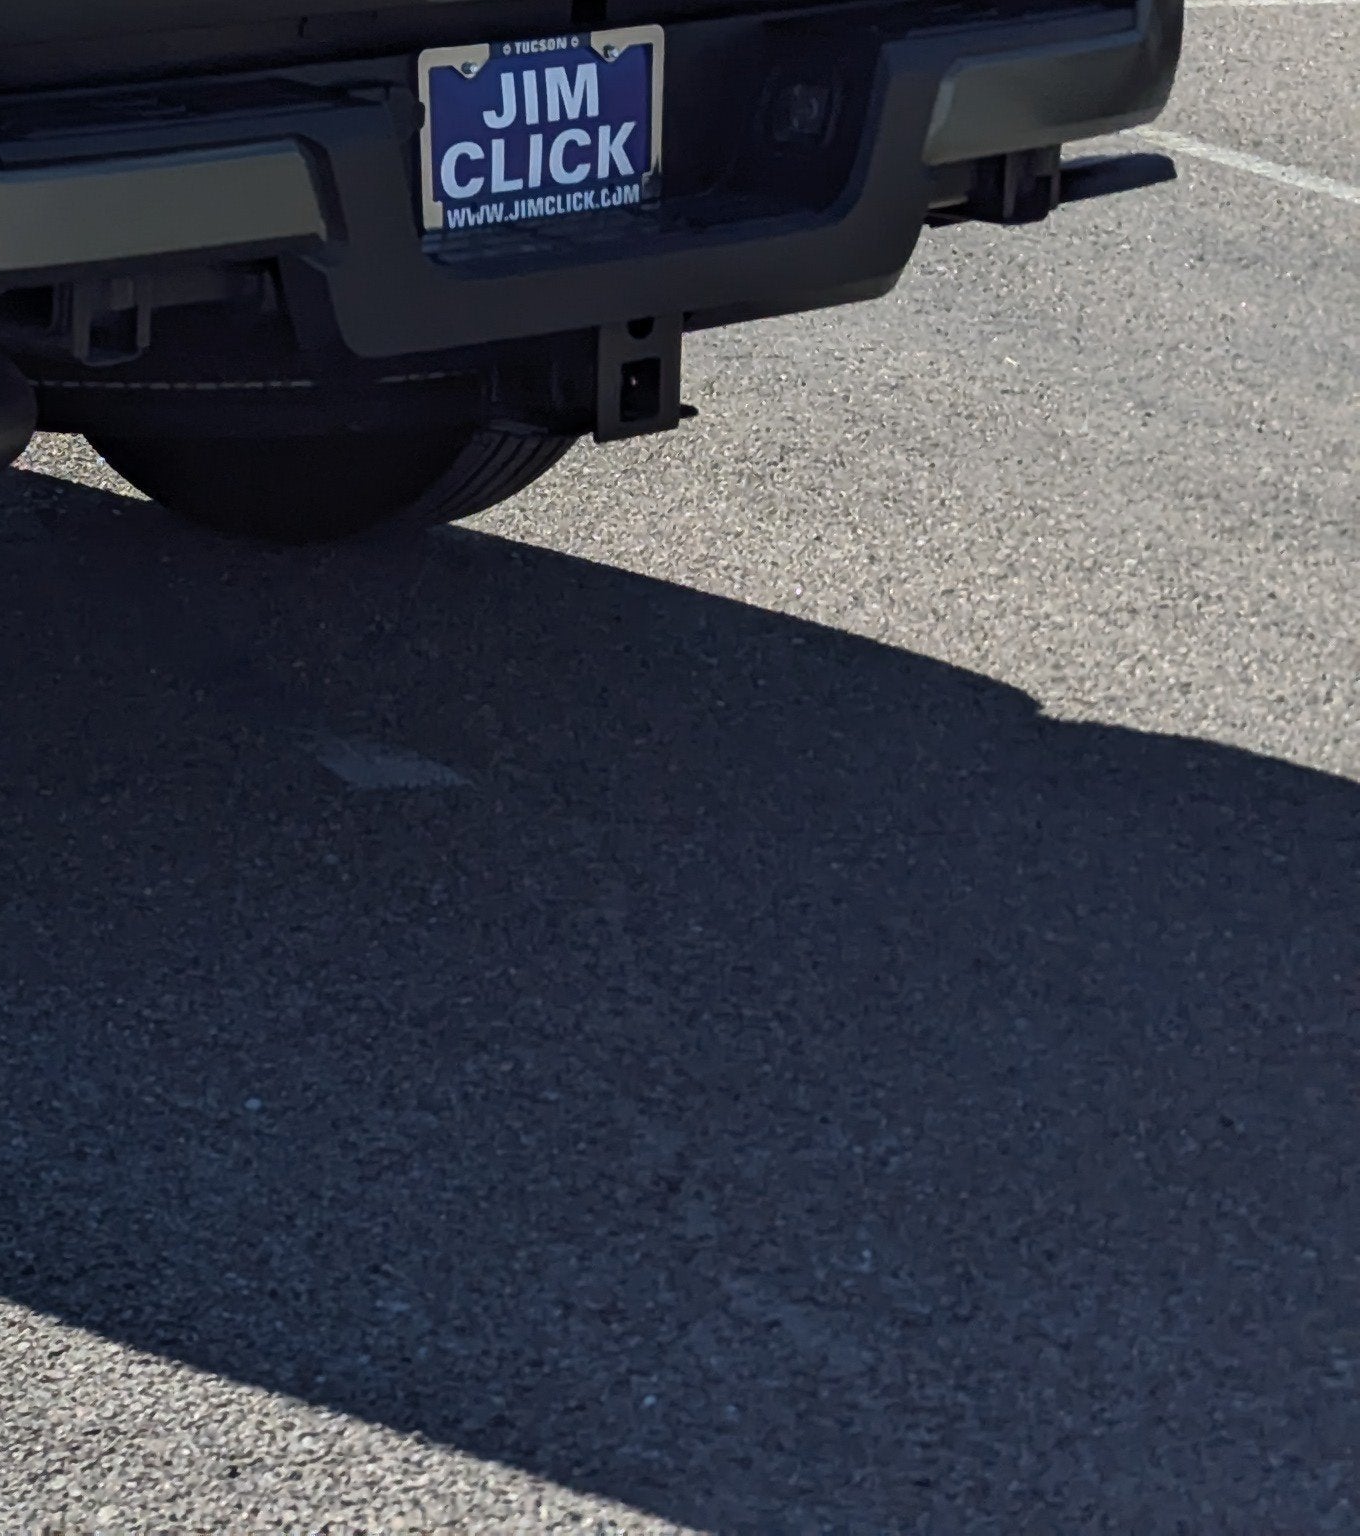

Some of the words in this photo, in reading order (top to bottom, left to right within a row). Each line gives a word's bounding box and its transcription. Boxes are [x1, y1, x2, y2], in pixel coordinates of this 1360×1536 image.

[514, 37, 567, 55] TUCSON
[483, 63, 600, 129] JIM
[440, 121, 637, 199] CLICK
[447, 183, 640, 229] WWW.JIMCLICK.COM
